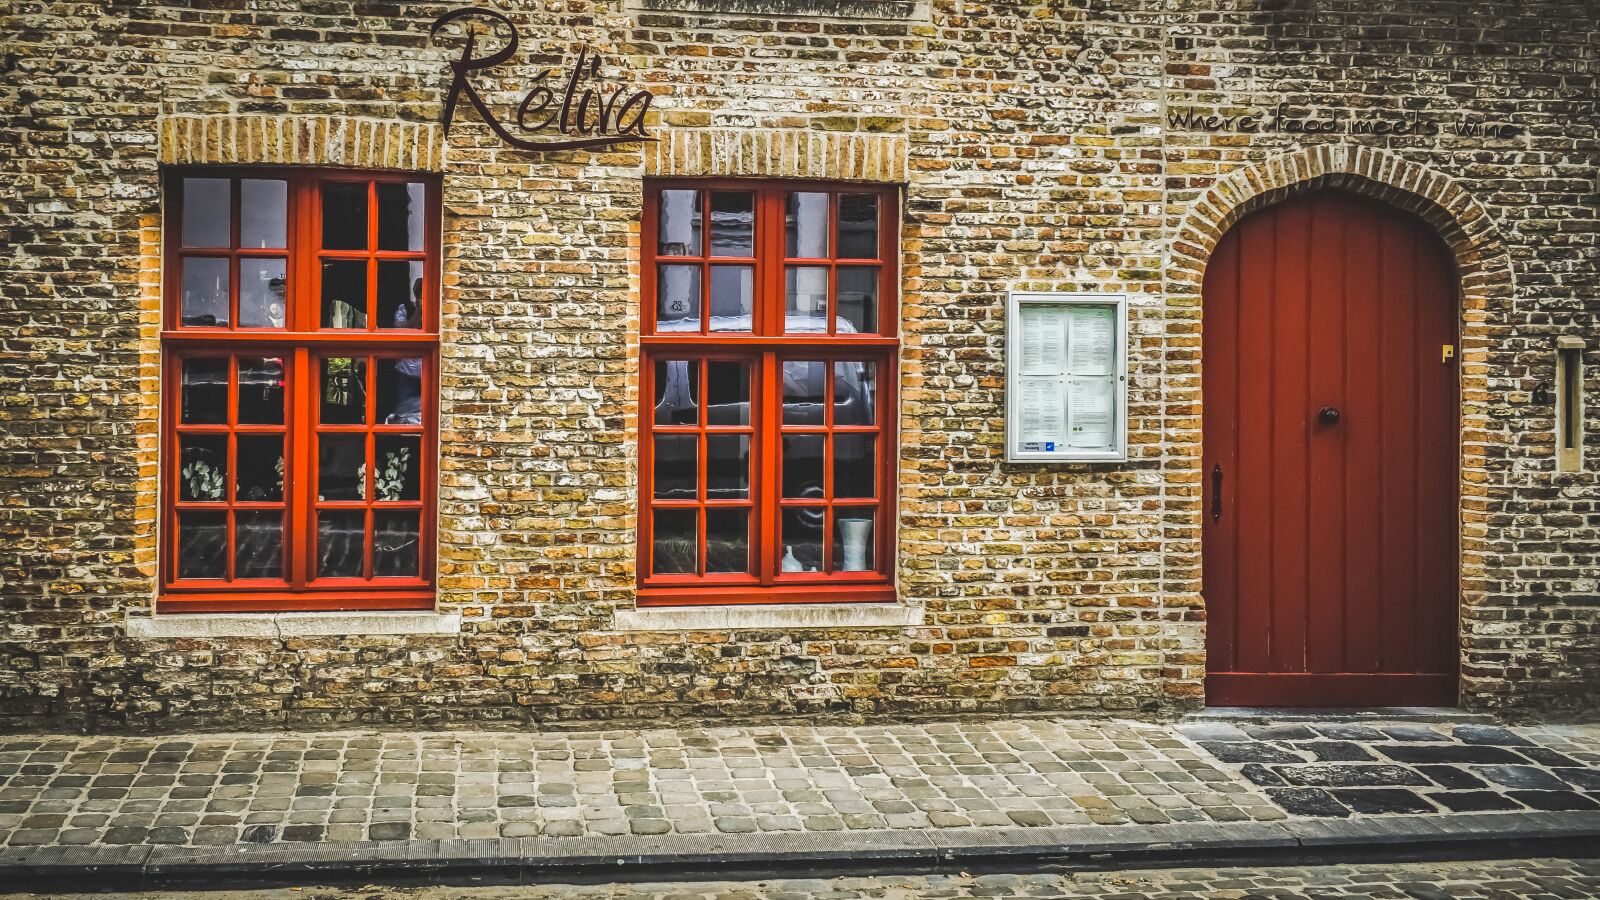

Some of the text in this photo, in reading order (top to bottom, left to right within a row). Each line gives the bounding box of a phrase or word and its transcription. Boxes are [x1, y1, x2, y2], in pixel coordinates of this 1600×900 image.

[430, 7, 661, 151] Réliva
[1274, 102, 1337, 132] food
[1350, 109, 1440, 135] meets
